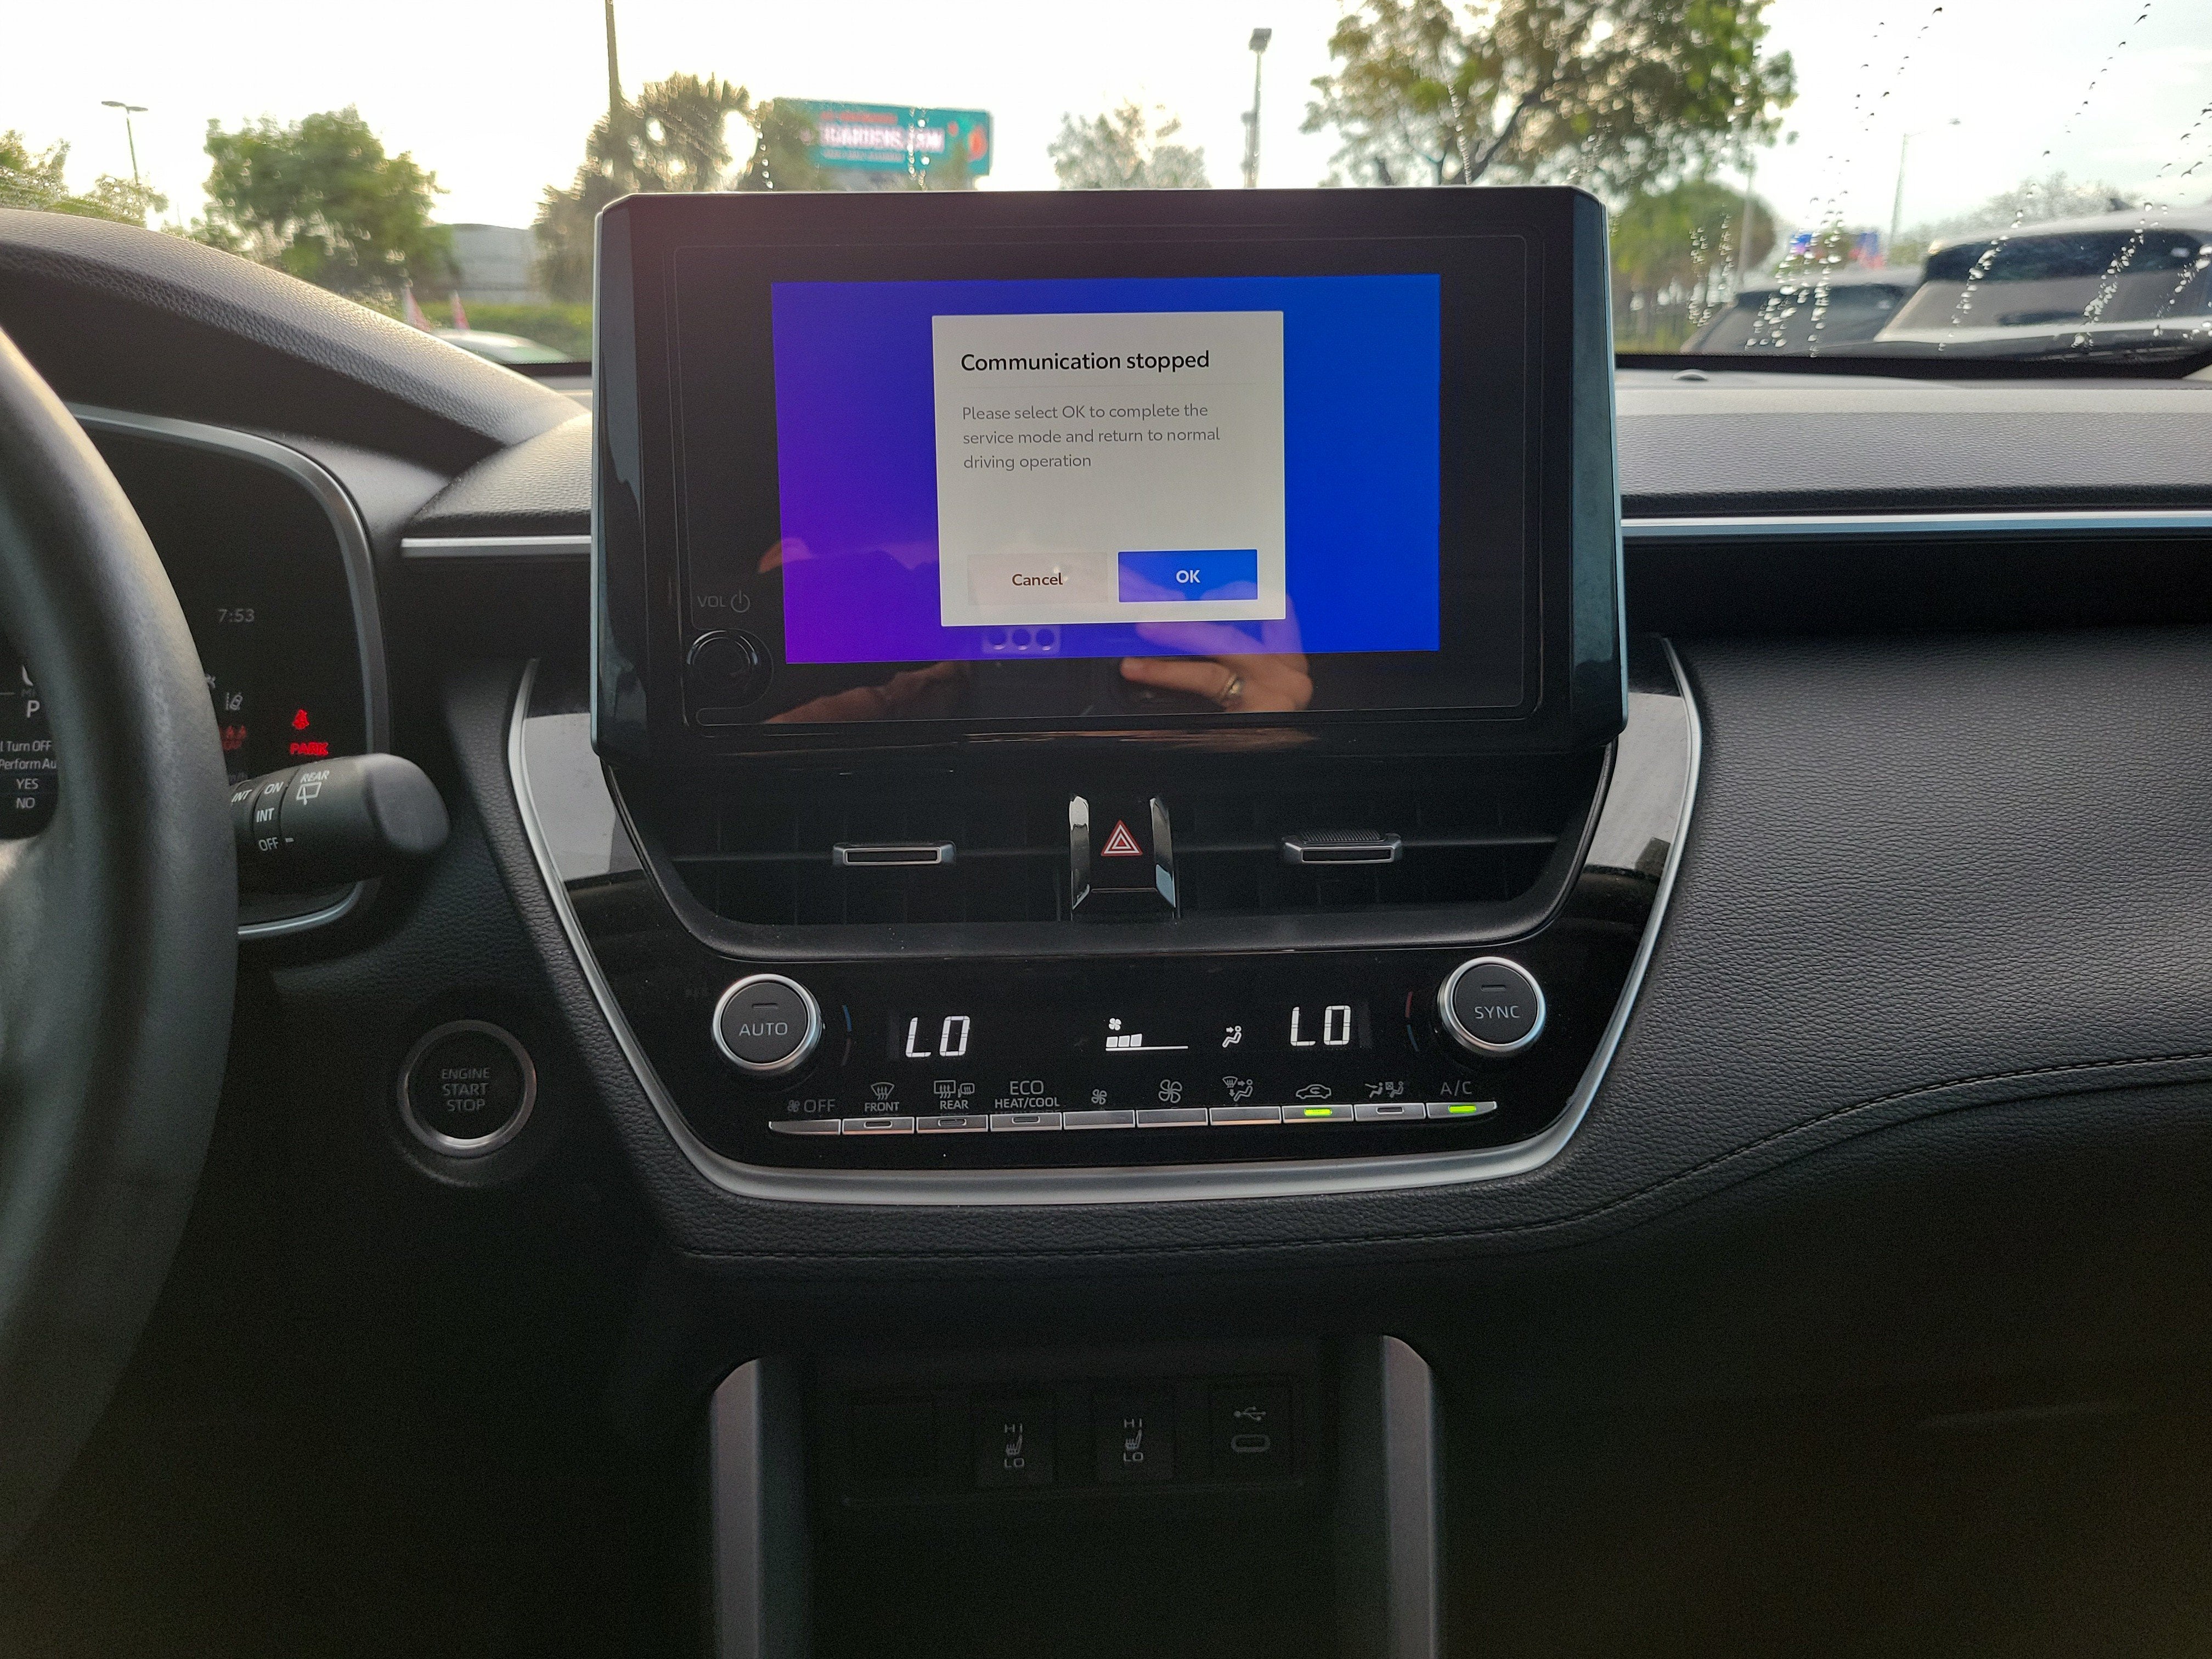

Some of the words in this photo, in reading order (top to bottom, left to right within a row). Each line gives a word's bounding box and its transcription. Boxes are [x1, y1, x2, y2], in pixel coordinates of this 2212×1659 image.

[961, 352, 1121, 371] Communication
[1126, 350, 1210, 373] stopped
[962, 406, 1011, 420] Please
[1014, 405, 1058, 419] select
[1062, 405, 1086, 419] OK
[1088, 405, 1105, 418] to
[1109, 404, 1180, 422] complete
[1183, 404, 1208, 416] the
[962, 431, 1014, 445] service
[1018, 430, 1062, 443] mode
[1065, 430, 1094, 443] and
[1097, 430, 1144, 442] return
[1147, 430, 1163, 441] to
[1166, 427, 1220, 441] normal
[963, 456, 1015, 471] driving
[1019, 454, 1092, 471] operation
[1011, 573, 1063, 586] Cancel
[1176, 570, 1200, 584] OK
[697, 596, 726, 607] VOL
[219, 608, 255, 623] 7:53
[26, 699, 41, 718] P
[7, 741, 30, 752] Turn
[32, 741, 52, 752] OFF
[290, 742, 329, 755] PARK
[301, 770, 330, 783] REAR
[16, 778, 38, 789] YES
[264, 782, 284, 794] ON
[231, 789, 252, 803] INT
[16, 797, 35, 809] NO
[256, 808, 274, 822] INT
[258, 837, 279, 851] OFF
[1474, 1005, 1520, 1019] SYNC
[738, 1022, 788, 1036] AUTO
[1290, 1005, 1351, 1047] LO
[905, 1015, 970, 1058] LO
[441, 1068, 490, 1079] ENGINE
[443, 1083, 488, 1096] START
[1009, 1080, 1043, 1095] ECO
[1440, 1080, 1472, 1096] A/C
[447, 1099, 485, 1111] STOP
[804, 1099, 836, 1112] OFF
[865, 1102, 899, 1111] FRONT
[940, 1100, 968, 1109] REAR
[995, 1097, 1059, 1108] HEAT/COOL
[1004, 1423, 1023, 1434] HI
[1124, 1418, 1143, 1428] HI
[1004, 1458, 1025, 1468] LO
[1122, 1452, 1144, 1463] LO
